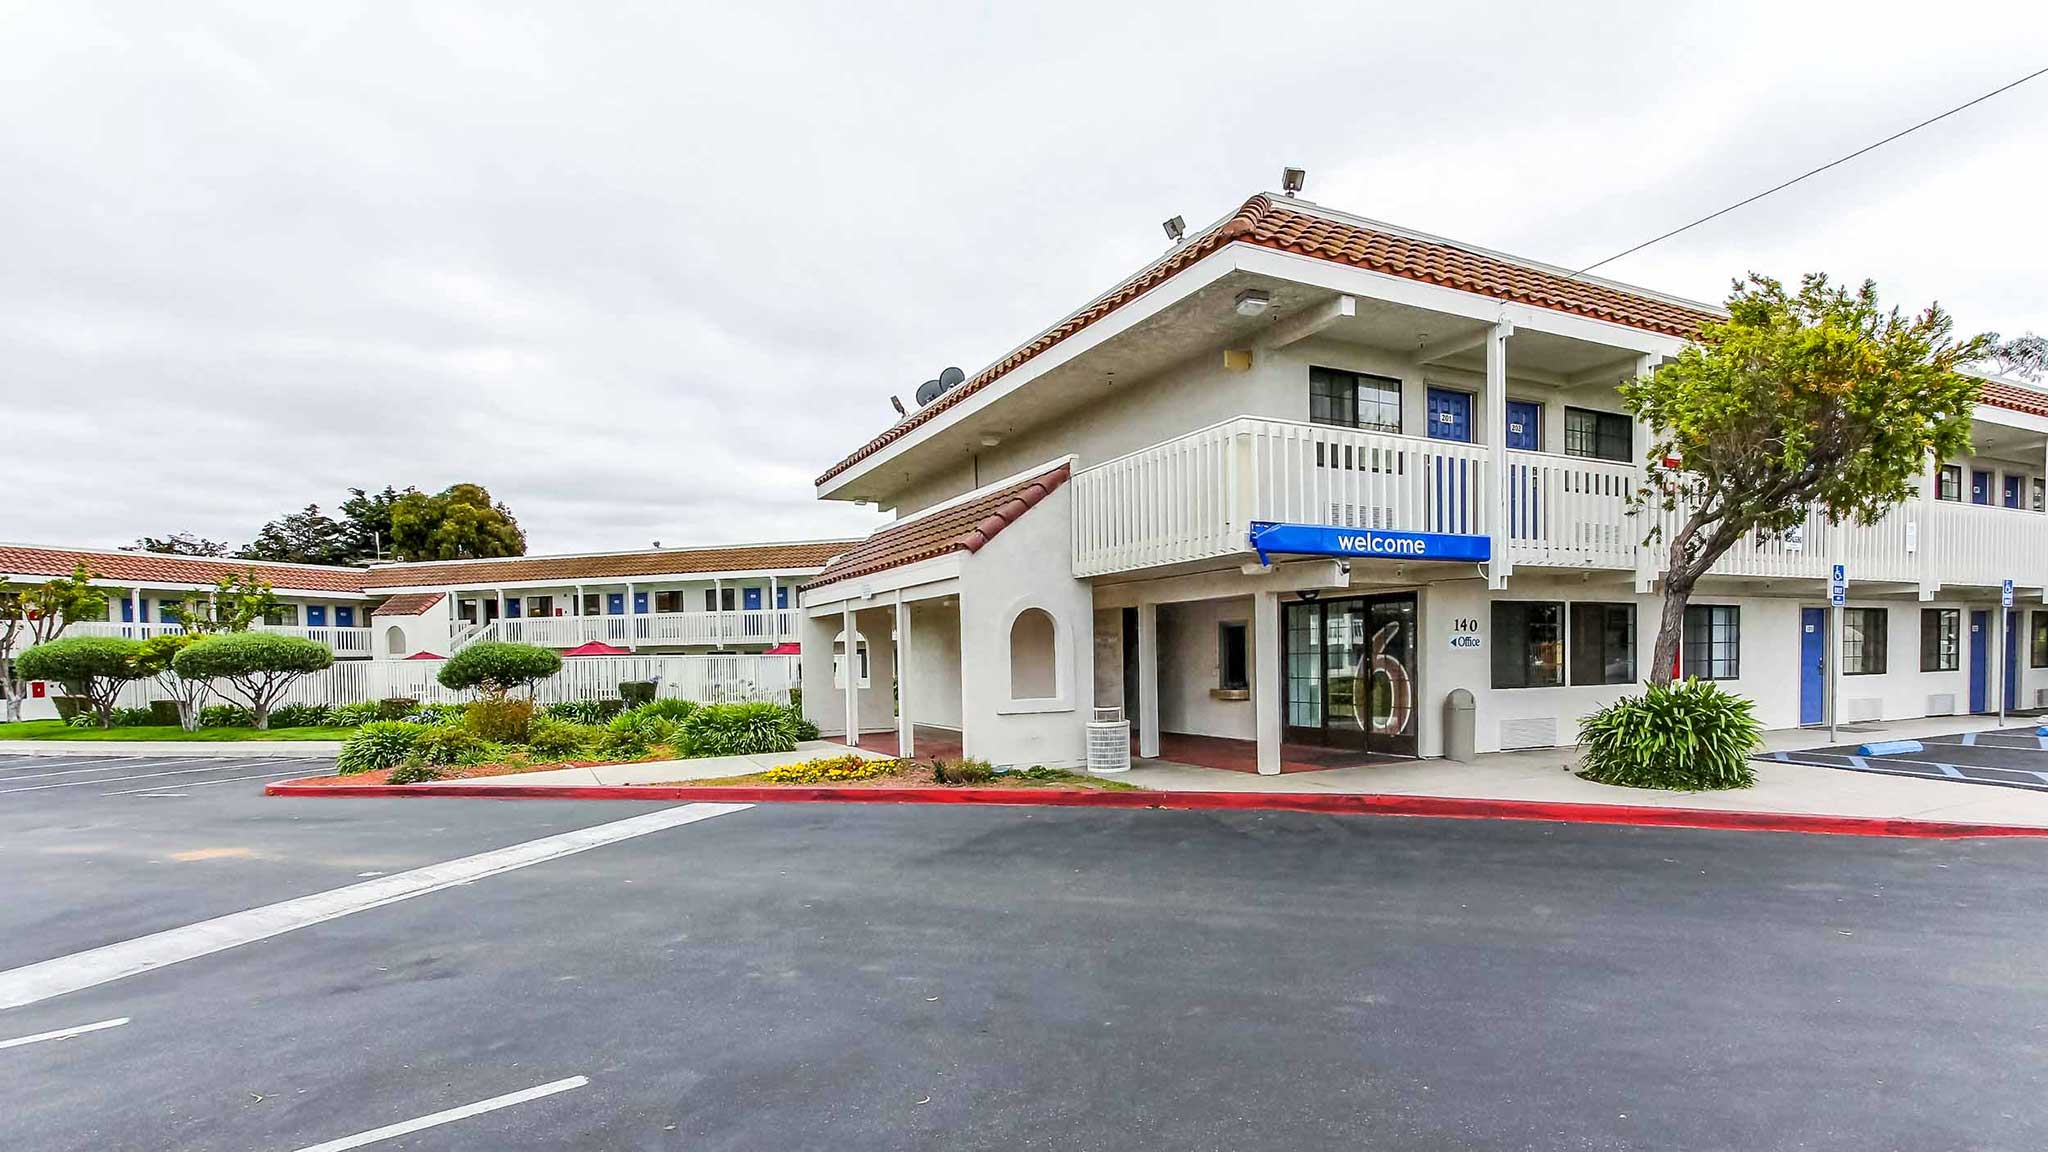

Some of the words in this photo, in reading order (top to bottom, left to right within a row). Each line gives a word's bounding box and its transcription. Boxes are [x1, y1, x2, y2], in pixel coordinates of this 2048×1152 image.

[1441, 414, 1452, 422] 201
[1511, 424, 1522, 432] 202
[1338, 532, 1426, 554] welcome
[1454, 618, 1478, 632] 140
[1458, 636, 1481, 647] Office
[1353, 621, 1411, 735] 6
